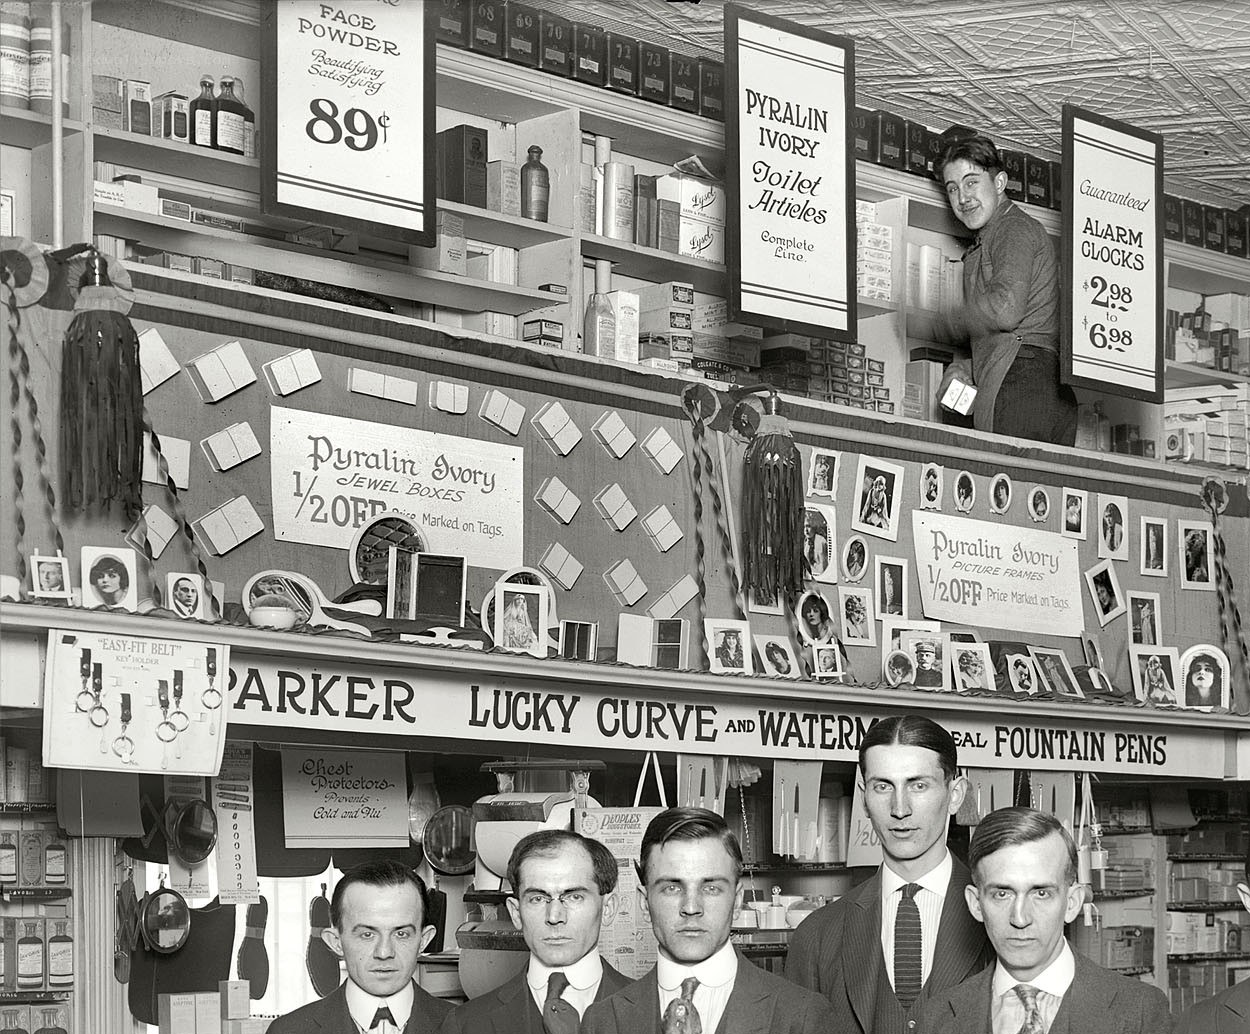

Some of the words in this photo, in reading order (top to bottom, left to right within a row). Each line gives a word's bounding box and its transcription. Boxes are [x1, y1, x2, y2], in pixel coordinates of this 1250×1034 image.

[320, 3, 376, 31] FACE
[478, 4, 496, 21] 68
[516, 14, 533, 29] 69
[298, 17, 401, 57] POWDER
[547, 24, 562, 40] 70
[583, 34, 597, 49] 71
[311, 49, 385, 80] Beautifying
[307, 64, 386, 96] Satisfying
[305, 98, 391, 151] 89¢
[745, 88, 828, 133] PYRALIN
[759, 127, 820, 158] IVORY
[752, 160, 822, 197] Toilet
[691, 185, 717, 210] Lysol
[748, 189, 828, 225] Articles
[1080, 179, 1150, 212] Guaranteed
[689, 226, 714, 254] Lysol
[761, 230, 815, 253] Complete
[1082, 217, 1144, 248] ALARM
[774, 246, 808, 263] Line.
[1081, 240, 1145, 271] CLOCKS
[1082, 275, 1133, 312] $2.98
[1106, 311, 1118, 323] to
[1082, 315, 1133, 353] $6.98
[307, 435, 419, 477] Pyralin
[431, 454, 497, 494] Ivory
[336, 473, 400, 494] JEWEL
[405, 482, 467, 503] BOXES
[422, 513, 460, 531] Marked
[462, 522, 476, 533] on
[478, 521, 505, 539] Tags.
[930, 530, 1003, 561] Pyralin
[1012, 542, 1060, 575] Ivory
[951, 561, 1000, 576] PICTURE
[1003, 568, 1046, 582] FRAMES
[987, 587, 1008, 602] Price
[1011, 591, 1039, 605] Marked
[1040, 598, 1050, 607] on
[115, 655, 127, 663] KEY
[132, 656, 160, 665] HOLDER
[469, 685, 581, 734] LUCKY
[597, 697, 719, 743] CURVE
[725, 718, 755, 734] AND
[758, 708, 880, 751] WATERM
[950, 731, 988, 748] EAL
[995, 725, 1106, 764] FOUNTAIN
[1115, 733, 1168, 766] PENS
[302, 758, 353, 776] Chest
[311, 775, 396, 791] Protectors
[324, 793, 370, 803] Prevents
[313, 806, 341, 820] Cold
[343, 809, 359, 819] and
